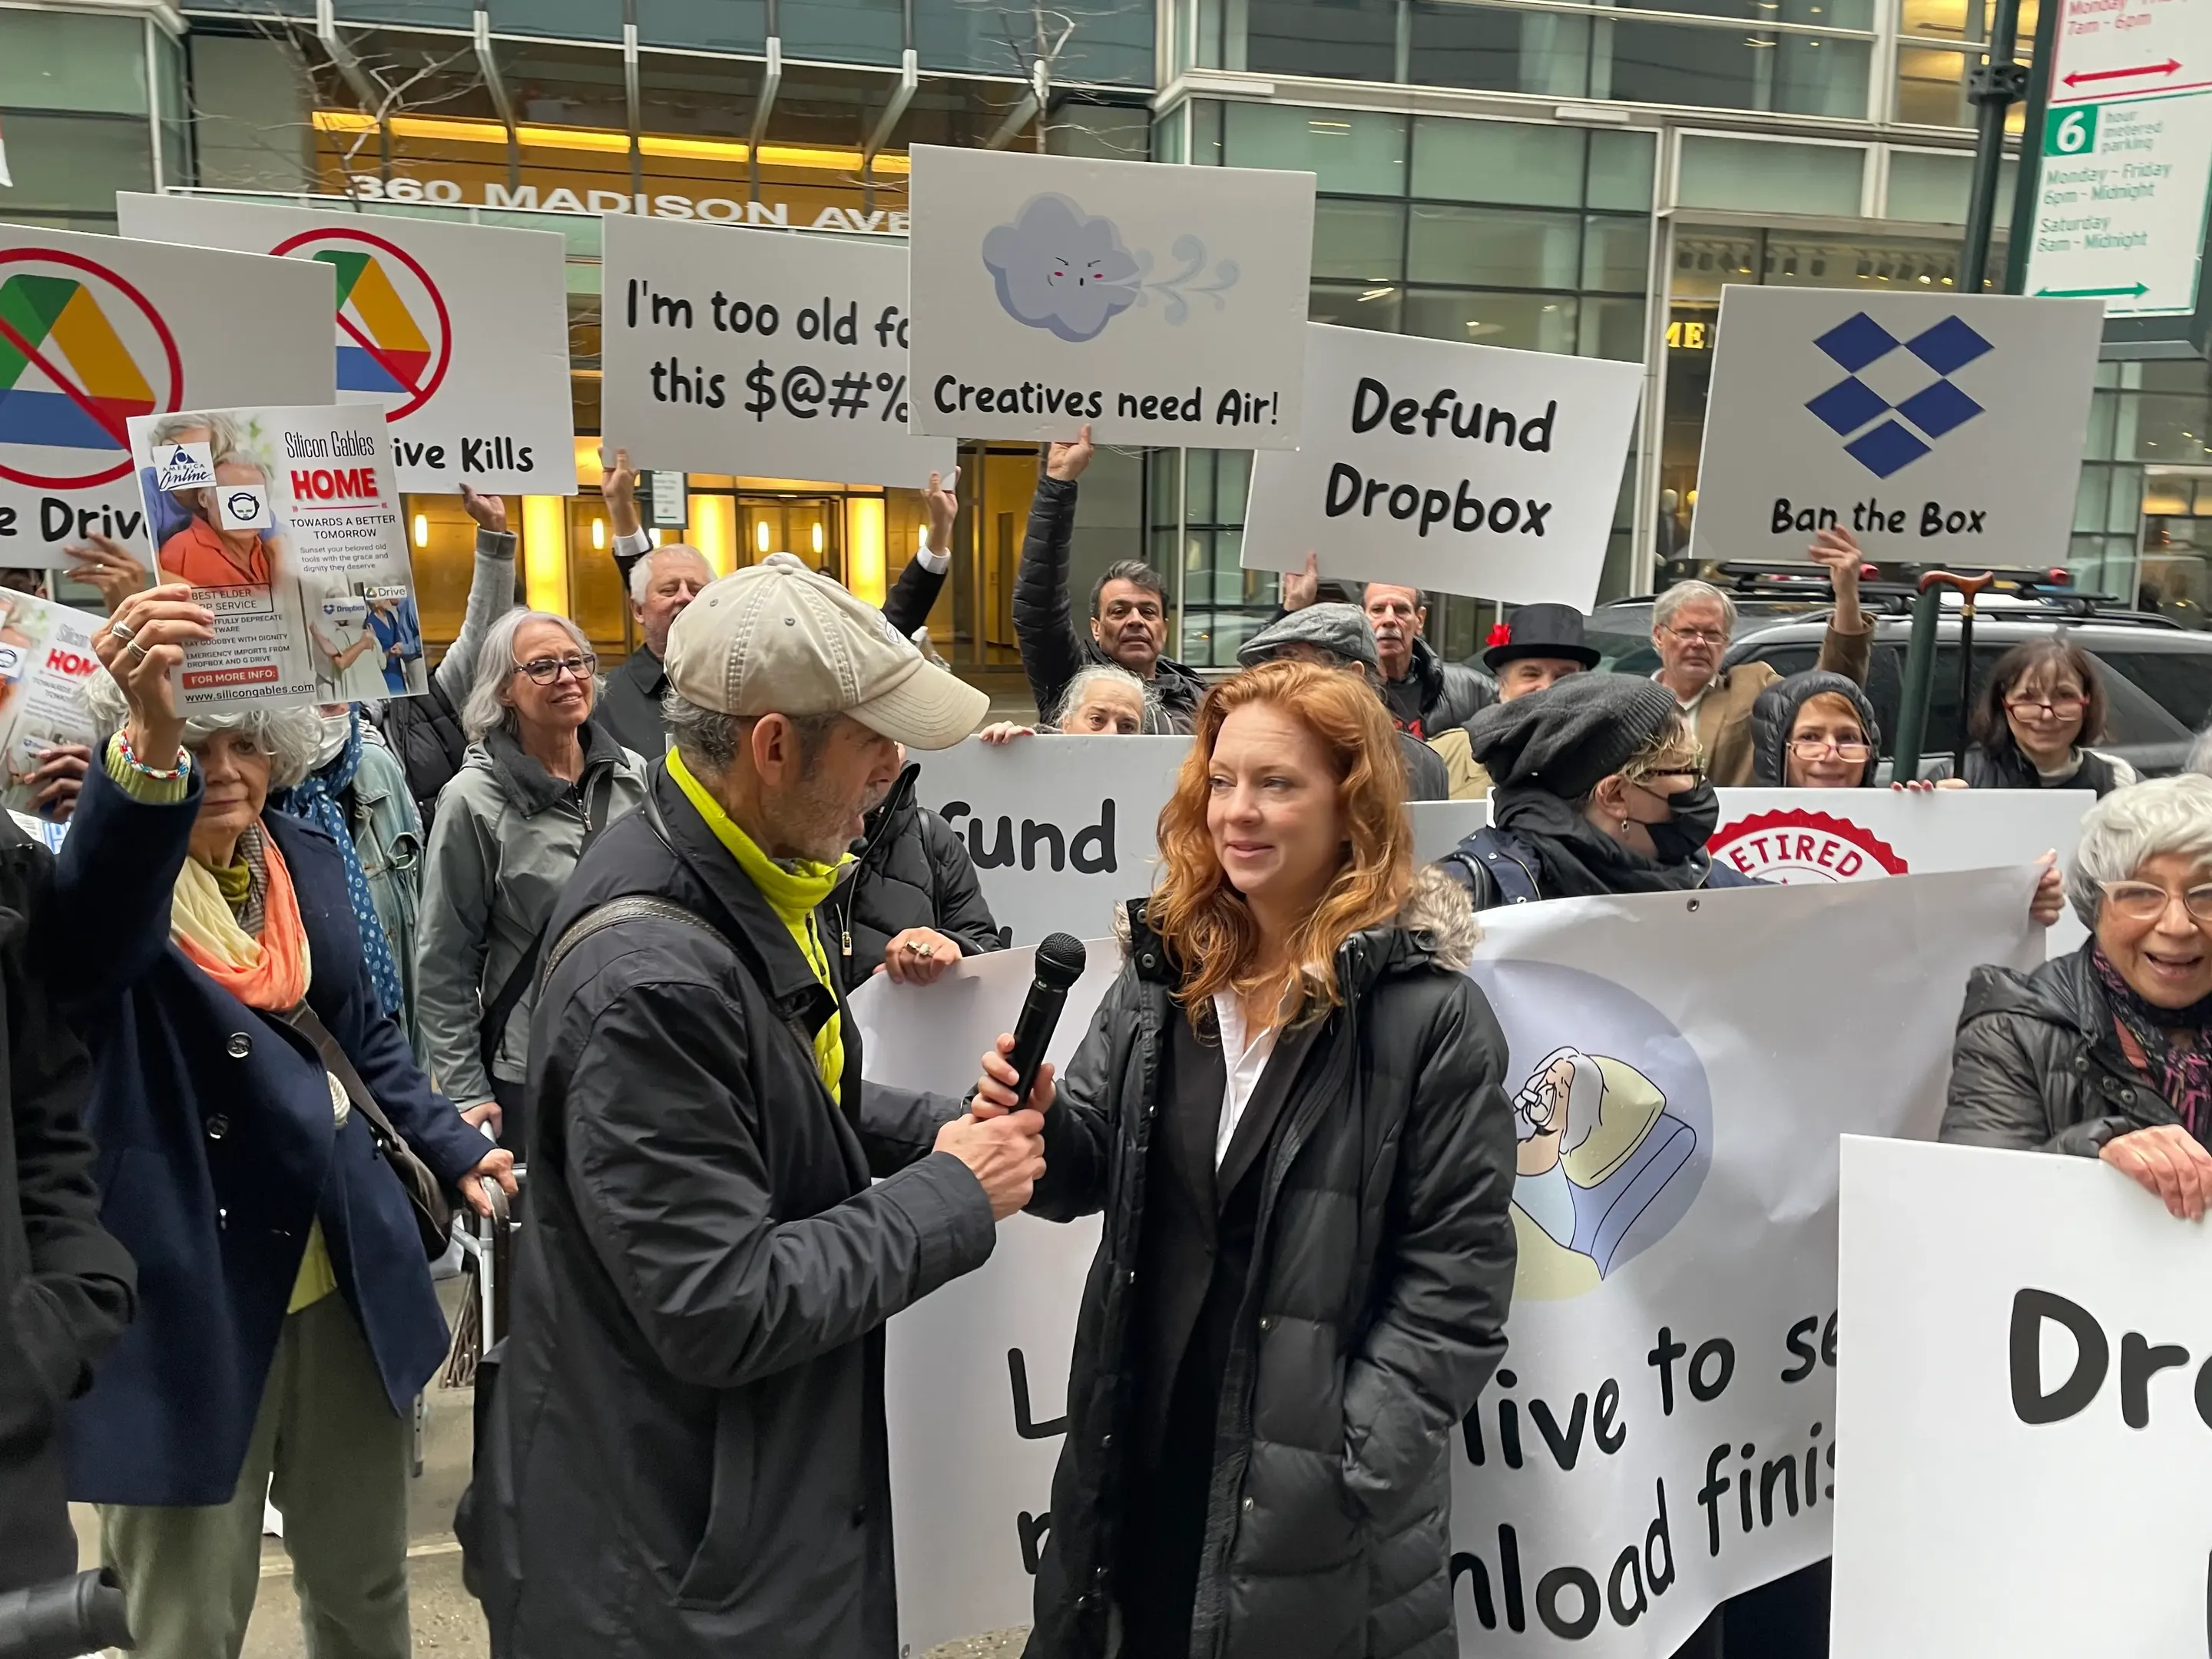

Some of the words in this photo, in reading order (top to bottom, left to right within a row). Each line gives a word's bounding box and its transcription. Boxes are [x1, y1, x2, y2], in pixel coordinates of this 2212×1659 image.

[2105, 111, 2138, 124] hour
[2057, 111, 2086, 152] 6
[2101, 137, 2154, 156] parking
[2046, 167, 2109, 186] Monday
[2122, 161, 2174, 180] Friday
[350, 175, 462, 204] 360
[484, 183, 788, 226] MADISON
[2044, 190, 2078, 207] 6pm
[2091, 182, 2154, 202] Midnight
[2039, 215, 2111, 233] Saturday
[2084, 230, 2148, 251] Midnight
[628, 278, 693, 329] I'm
[710, 290, 779, 336] too
[796, 296, 859, 346] old
[650, 356, 725, 409] this
[934, 374, 1103, 419] Creatives
[1118, 386, 1201, 422] need
[1216, 388, 1279, 426] Air!
[1352, 376, 1557, 453] Defund
[284, 432, 329, 459] Silicon
[331, 430, 375, 457] Gables
[392, 438, 445, 469] ive
[461, 436, 533, 473] Kills
[162, 463, 205, 472] AMERICA
[160, 469, 213, 490] Online
[290, 467, 379, 501] HOME
[1326, 462, 1552, 538] Dropbox
[41, 497, 148, 542] Driv
[290, 518, 343, 528] TOWARDS
[346, 517, 353, 525] A
[356, 515, 396, 525] BETTER
[1770, 498, 1838, 534] Ban
[1853, 497, 1907, 534] the
[1919, 502, 1987, 538] Box
[313, 528, 377, 539] TOMORROW
[327, 546, 343, 555] your
[345, 544, 373, 552] beloved
[353, 554, 373, 562] grace
[303, 565, 328, 573] dignity
[191, 591, 216, 600] BEST
[220, 589, 252, 598] ELDER
[378, 587, 406, 597] Drive
[215, 600, 257, 611] SERVICE
[241, 614, 283, 623] DEPRECATE
[200, 637, 237, 646] GOODBYE
[47, 647, 101, 676] HOM
[186, 651, 232, 660] EMERGENCY
[234, 647, 267, 656] IMPORTS
[187, 660, 224, 668] DROPBOX
[250, 655, 270, 664] DRIVE
[191, 674, 213, 685] FOR
[215, 672, 246, 682] MORE
[248, 669, 276, 680] INFO:
[185, 683, 315, 702] www.silicongables.com
[1728, 833, 1863, 877] ETIRED
[1647, 1326, 1735, 1416] to
[1451, 1477, 1675, 1641] nload
